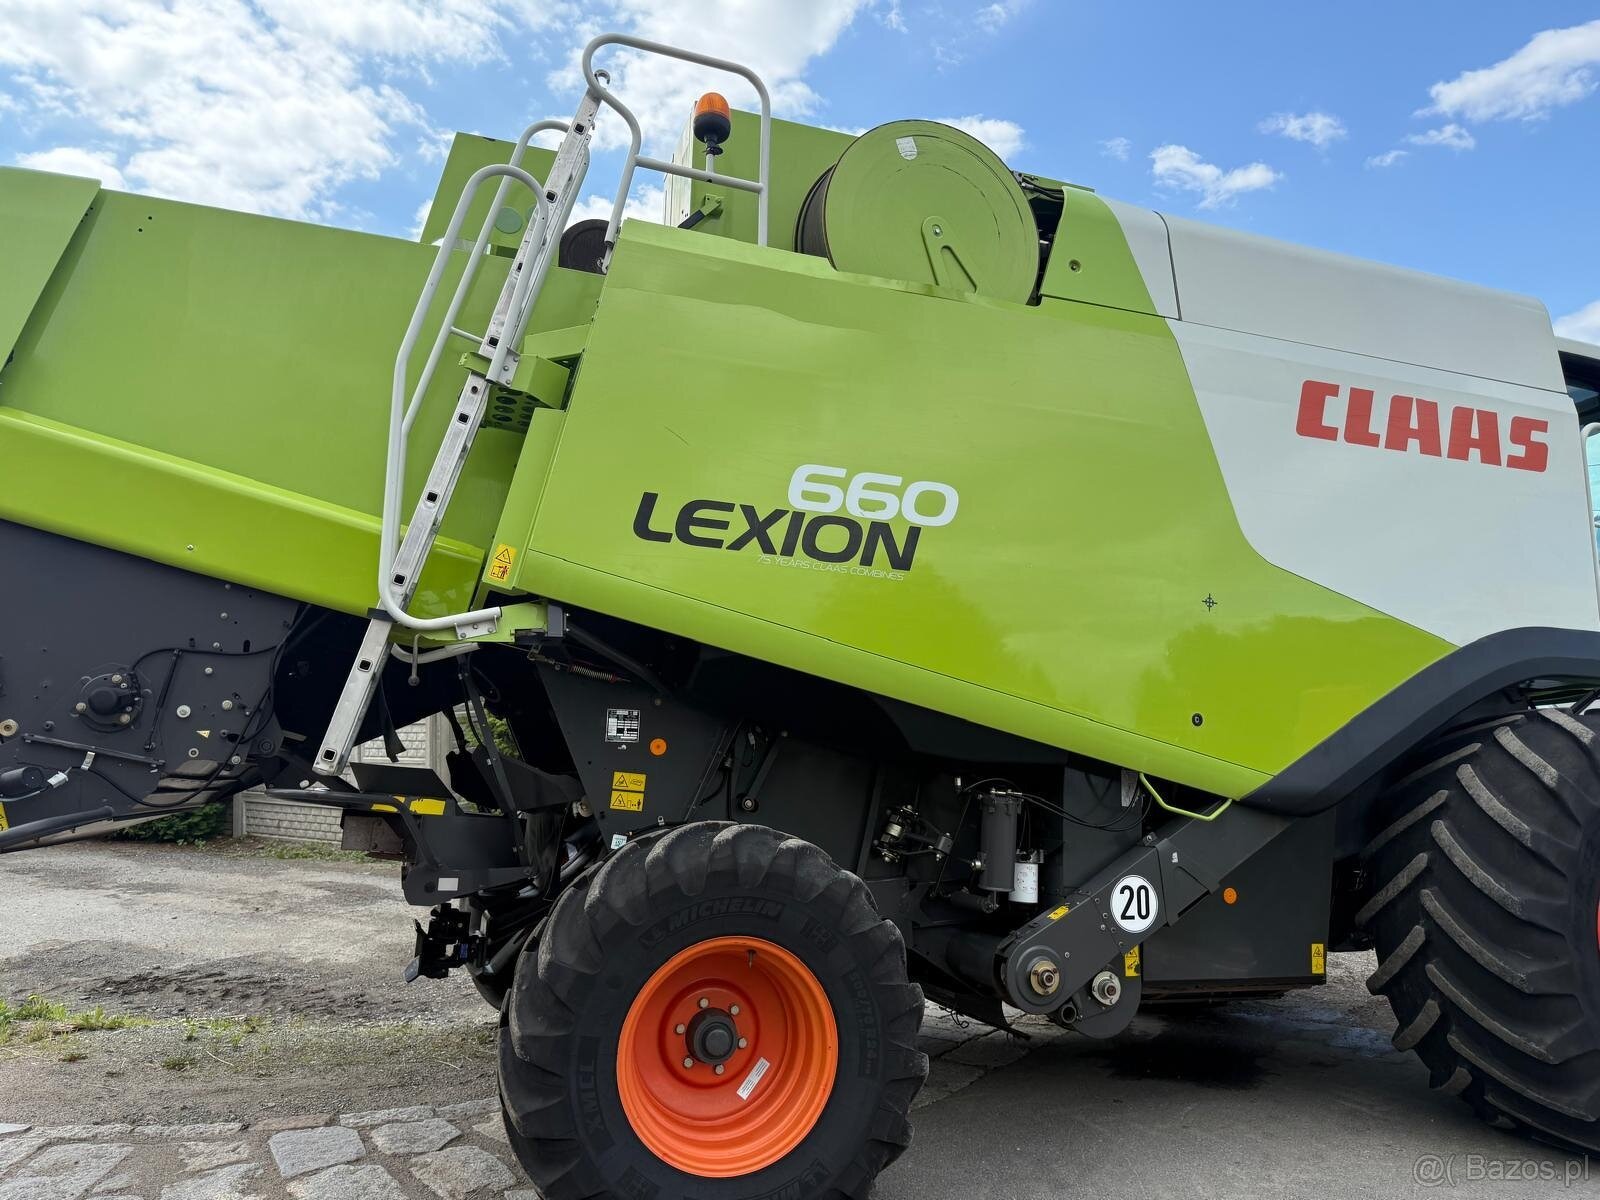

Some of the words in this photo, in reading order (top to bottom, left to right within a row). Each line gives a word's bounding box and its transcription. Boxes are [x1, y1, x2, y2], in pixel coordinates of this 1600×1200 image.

[1296, 379, 1549, 472] CLAAS
[788, 464, 959, 527] 660
[632, 491, 922, 571] LEXION
[774, 557, 810, 569] YEARS
[812, 561, 848, 574] CLAAS
[850, 566, 904, 581] COMBINES
[667, 897, 783, 932] MICHELIN
[1119, 884, 1150, 920] 20
